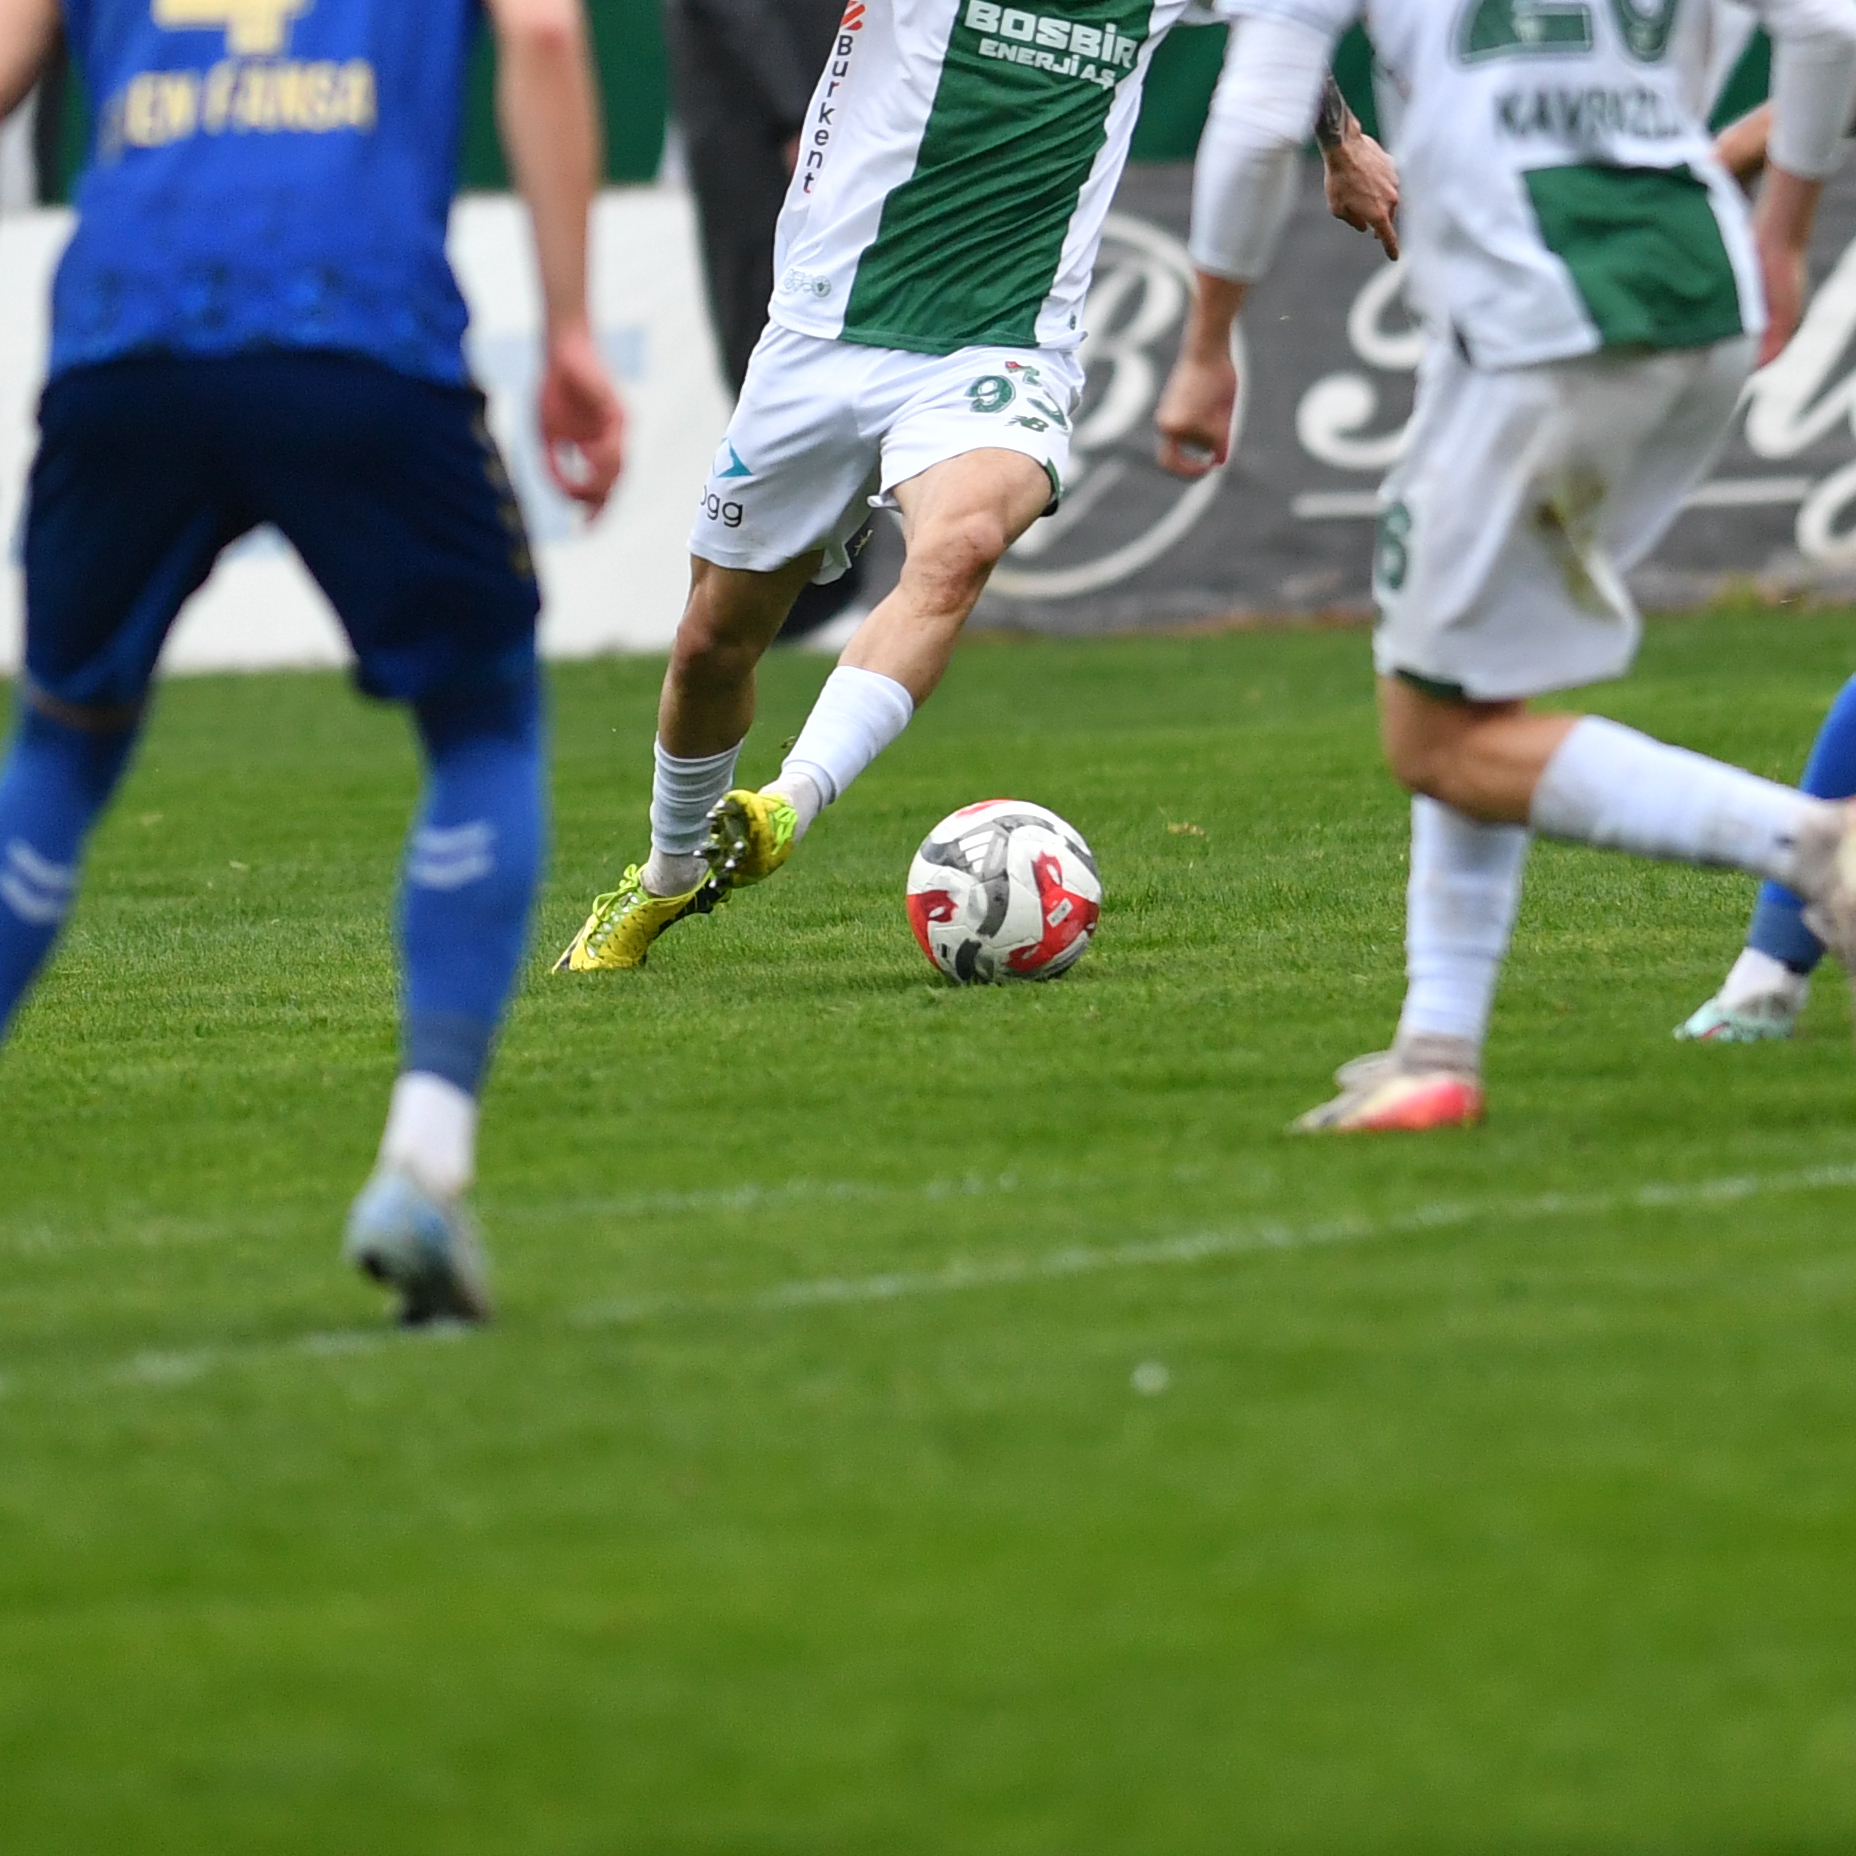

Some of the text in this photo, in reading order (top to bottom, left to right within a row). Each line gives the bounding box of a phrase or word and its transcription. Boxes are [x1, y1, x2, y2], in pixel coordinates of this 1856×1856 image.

[964, 0, 1138, 69] BOSBİR
[978, 38, 1081, 77] ENERJİ
[803, 35, 854, 194] Burkent
